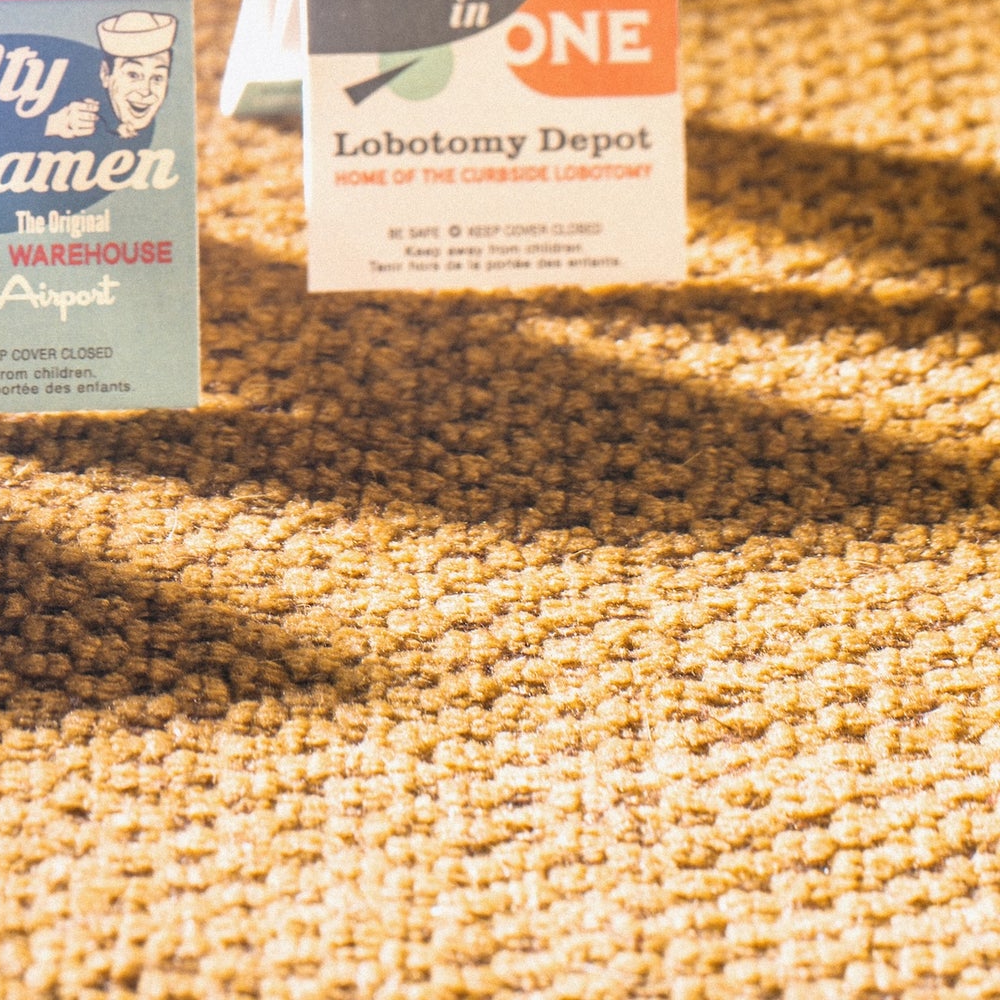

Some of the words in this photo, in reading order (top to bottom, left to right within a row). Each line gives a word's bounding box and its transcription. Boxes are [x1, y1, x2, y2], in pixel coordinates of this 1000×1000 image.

[506, 9, 653, 67] ONE
[334, 130, 527, 160] Lobotomy
[539, 127, 652, 157] Depot
[334, 169, 388, 186] HOME
[392, 168, 416, 185] OF
[422, 167, 456, 184] THE
[460, 165, 550, 183] CURBSIDE
[554, 163, 654, 181] LOBOTOMY
[15, 210, 45, 234] The
[48, 209, 111, 238] Original
[8, 241, 173, 267] WAREHOUSE
[12, 348, 57, 361] COVER
[61, 346, 113, 360] CLOSED
[33, 367, 97, 379] children.
[45, 382, 72, 395] des
[77, 381, 135, 393] enfants.
